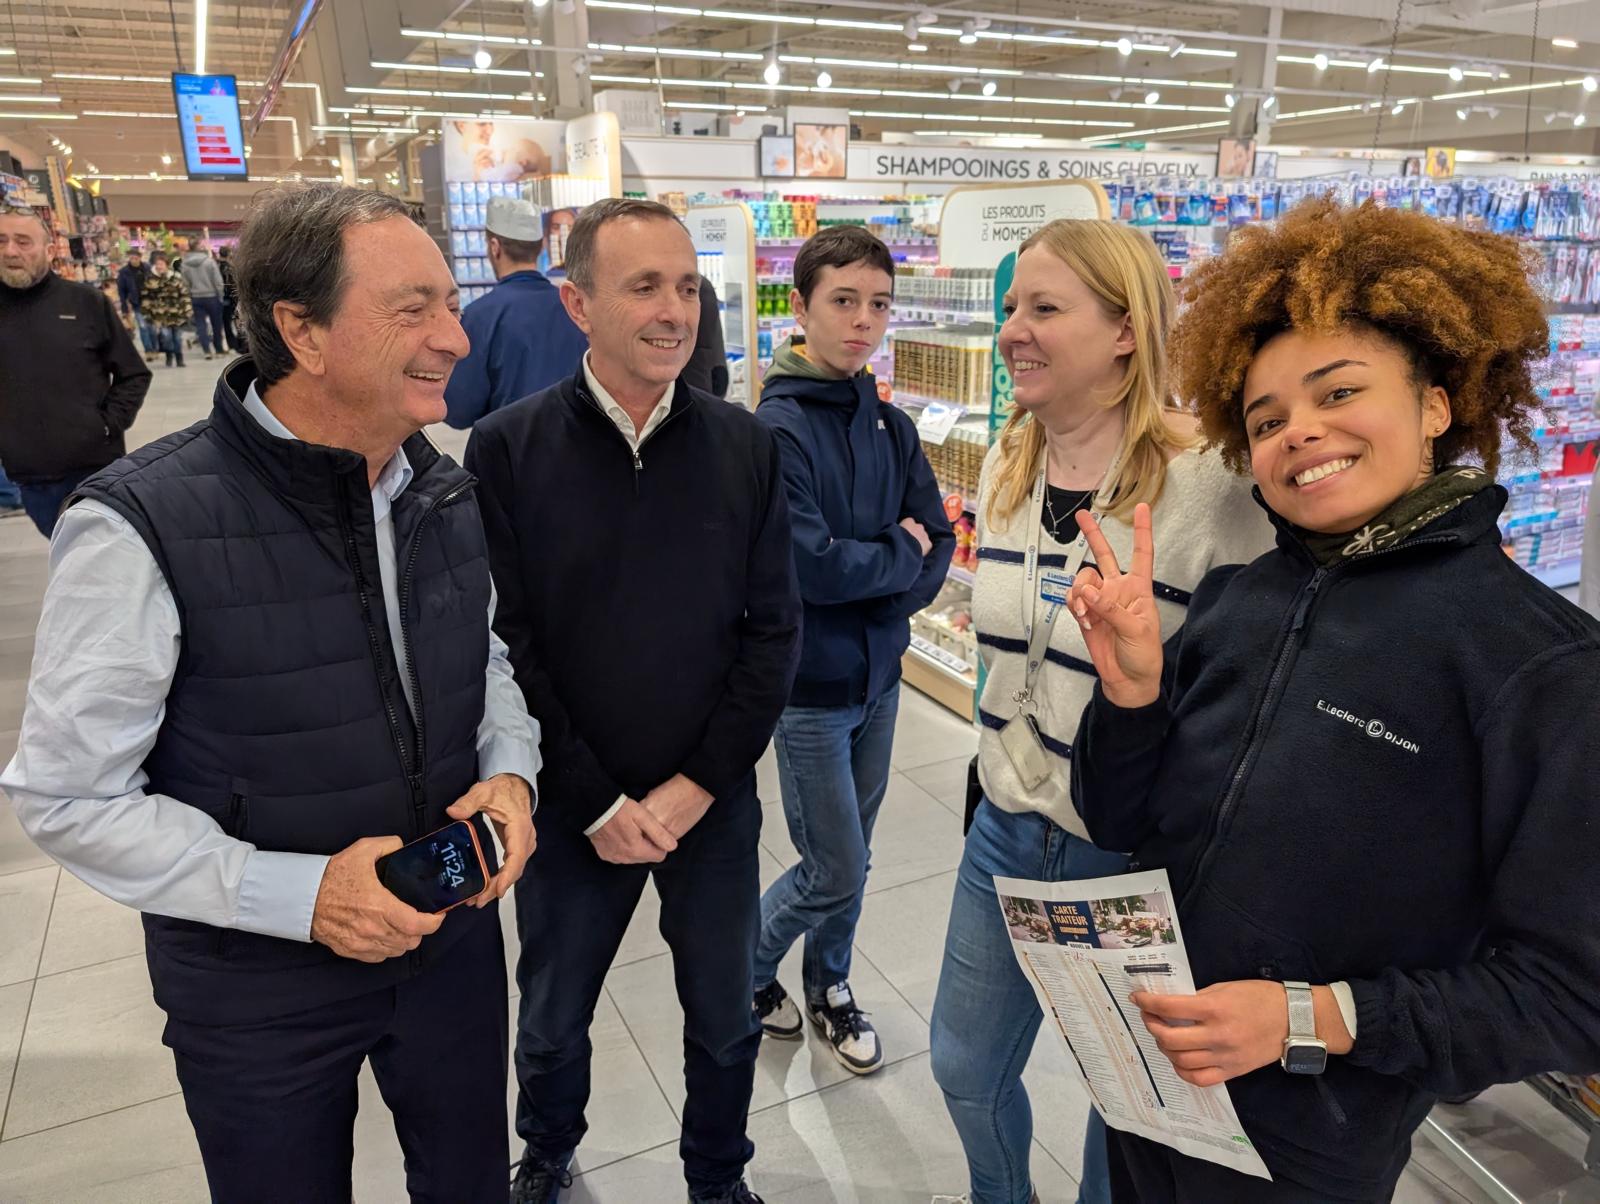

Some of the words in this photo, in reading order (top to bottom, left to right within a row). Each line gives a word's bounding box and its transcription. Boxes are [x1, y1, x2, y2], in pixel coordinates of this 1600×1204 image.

[877, 155, 1030, 179] SHAMPOOINGS
[1037, 160, 1050, 179] &
[1059, 160, 1113, 179] SOINS
[982, 206, 998, 219] LES
[1000, 204, 1046, 219] PRODUITS
[1317, 699, 1366, 729] E.Leclerc
[1384, 731, 1420, 754] DIJON
[441, 842, 465, 888] 11:24
[1053, 905, 1078, 915] CARTE
[1051, 914, 1088, 926] TRAITEUR
